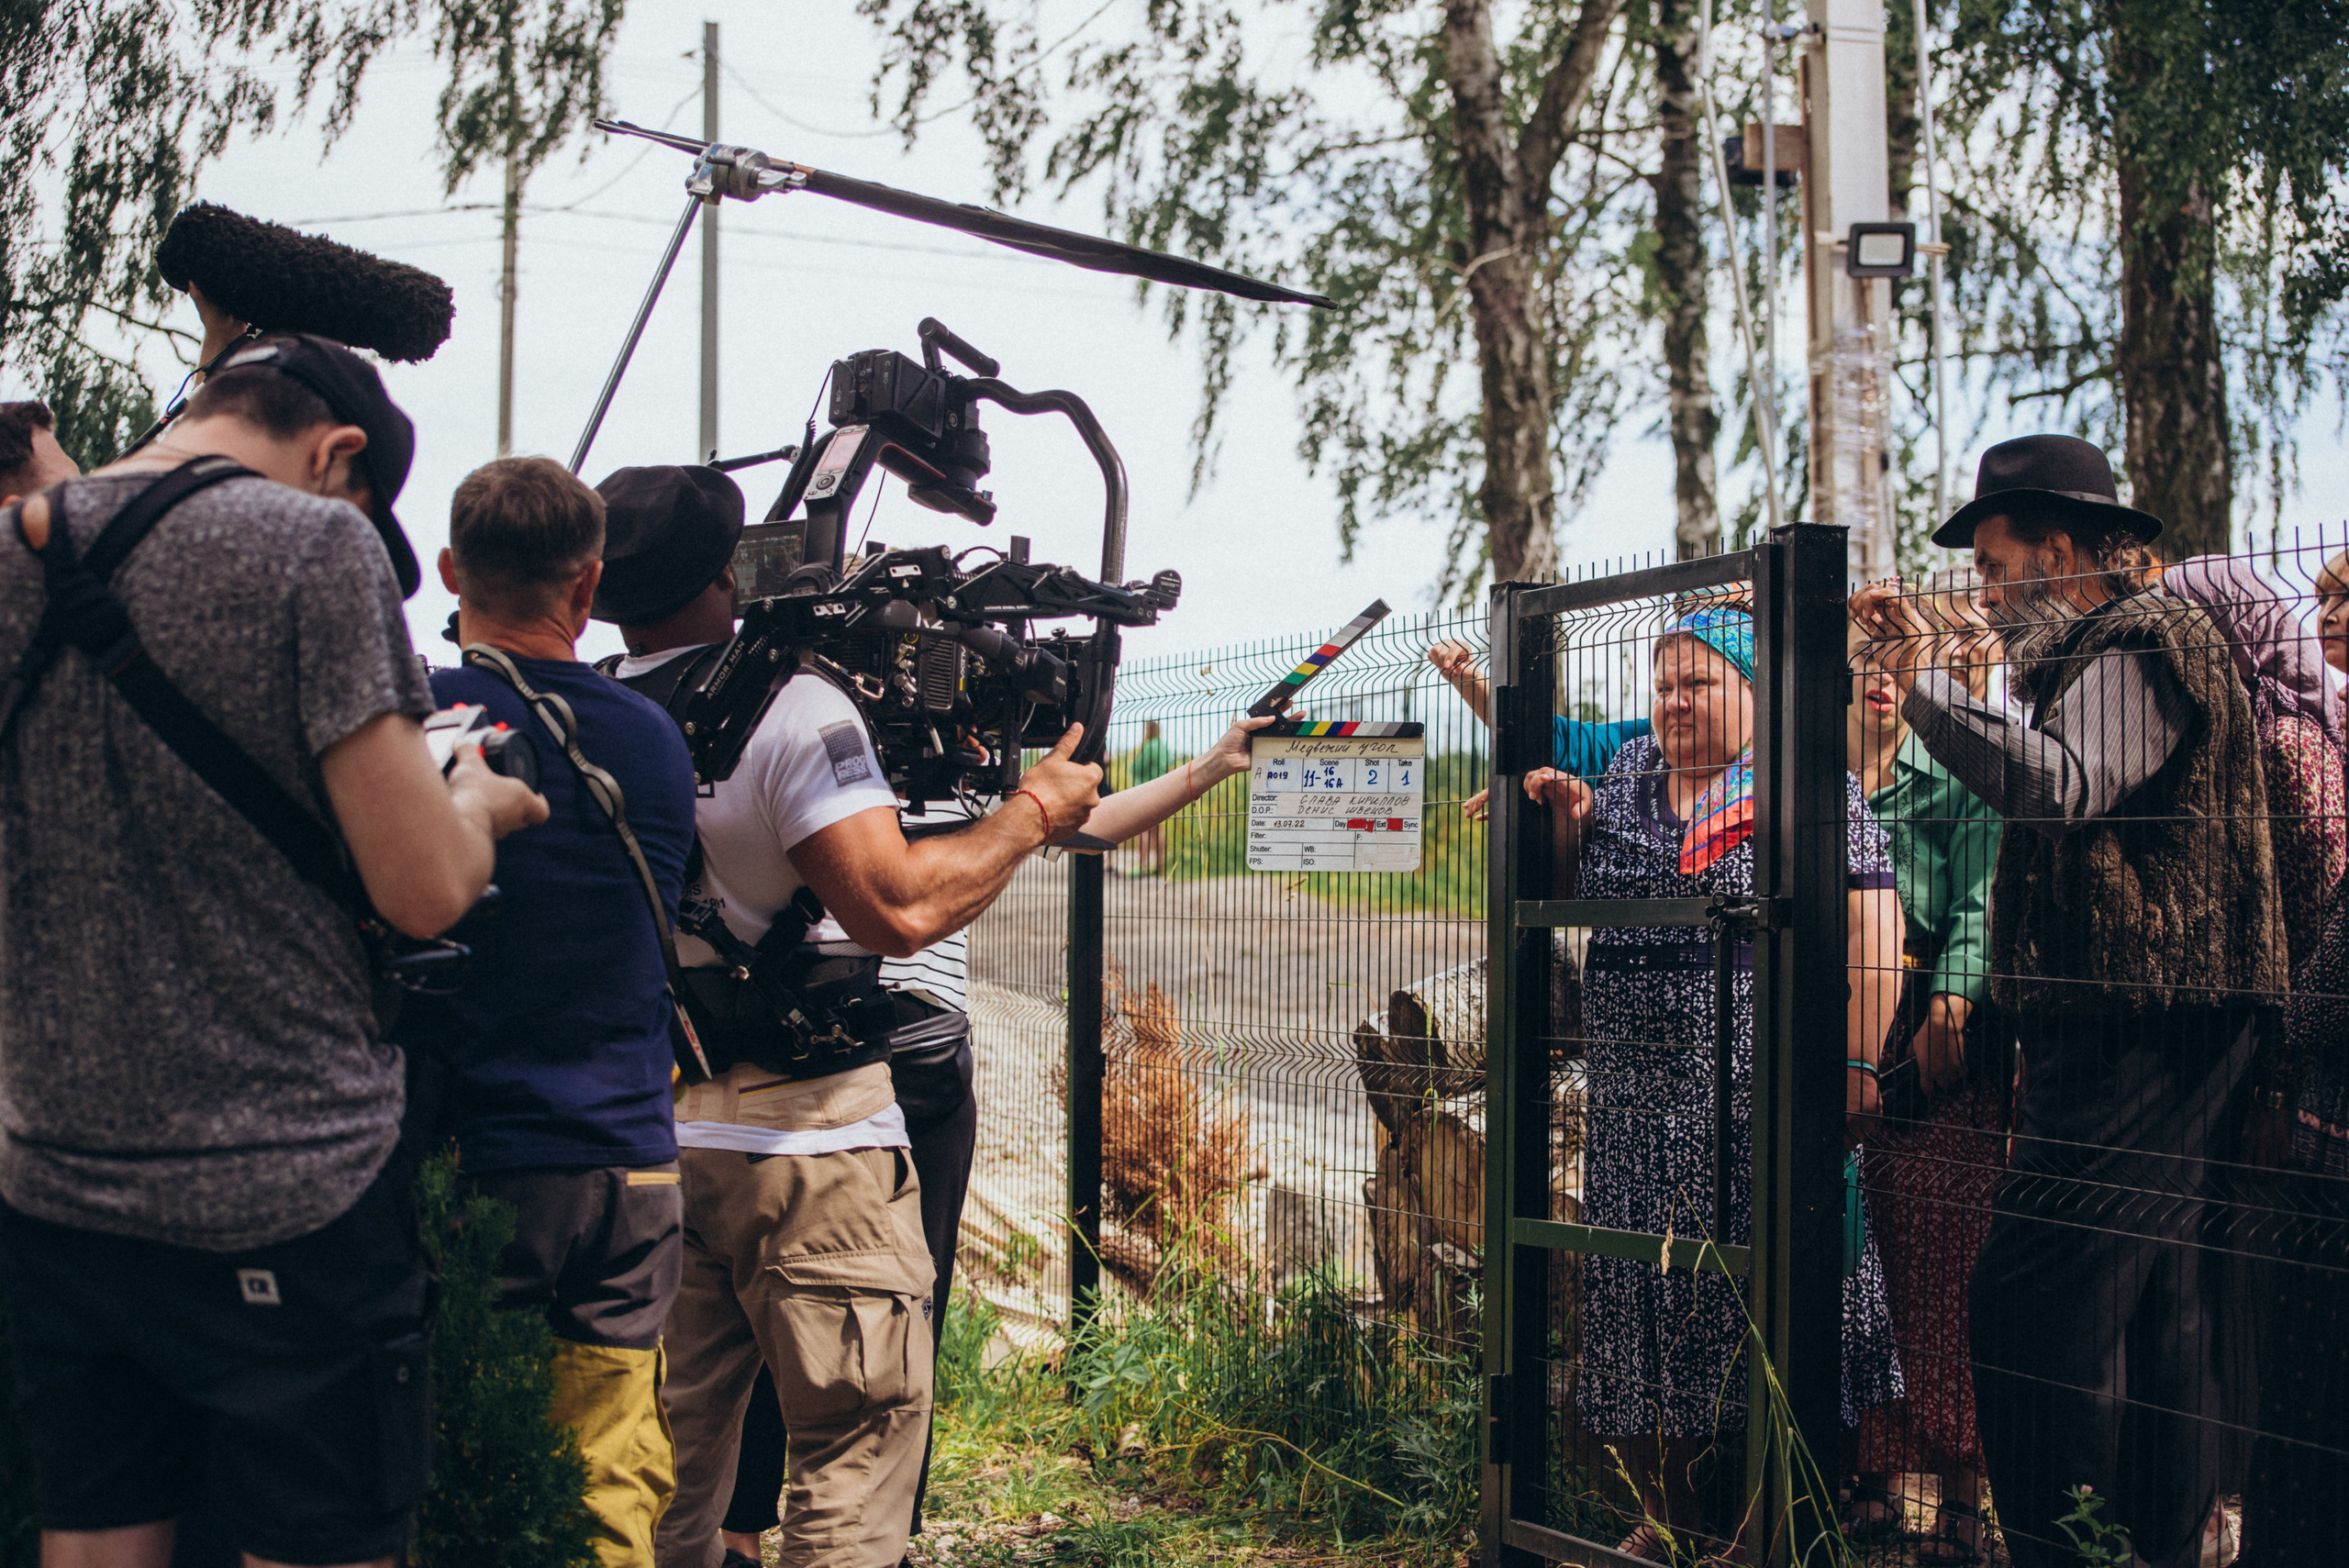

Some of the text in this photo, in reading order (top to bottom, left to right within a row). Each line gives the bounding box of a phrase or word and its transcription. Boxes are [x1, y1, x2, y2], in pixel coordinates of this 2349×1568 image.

[707, 664, 730, 700] ARMOR
[729, 640, 745, 663] MAN
[1286, 740, 1398, 757] Медвежий угол
[1273, 758, 1285, 766] Roll
[1319, 758, 1340, 766] Scene
[1367, 769, 1377, 784] 2
[1401, 770, 1410, 785] 1
[1252, 794, 1278, 802] Director:
[1299, 795, 1341, 806] СЛАВА
[1335, 820, 1346, 828] Day
[1404, 821, 1418, 829] Sync
